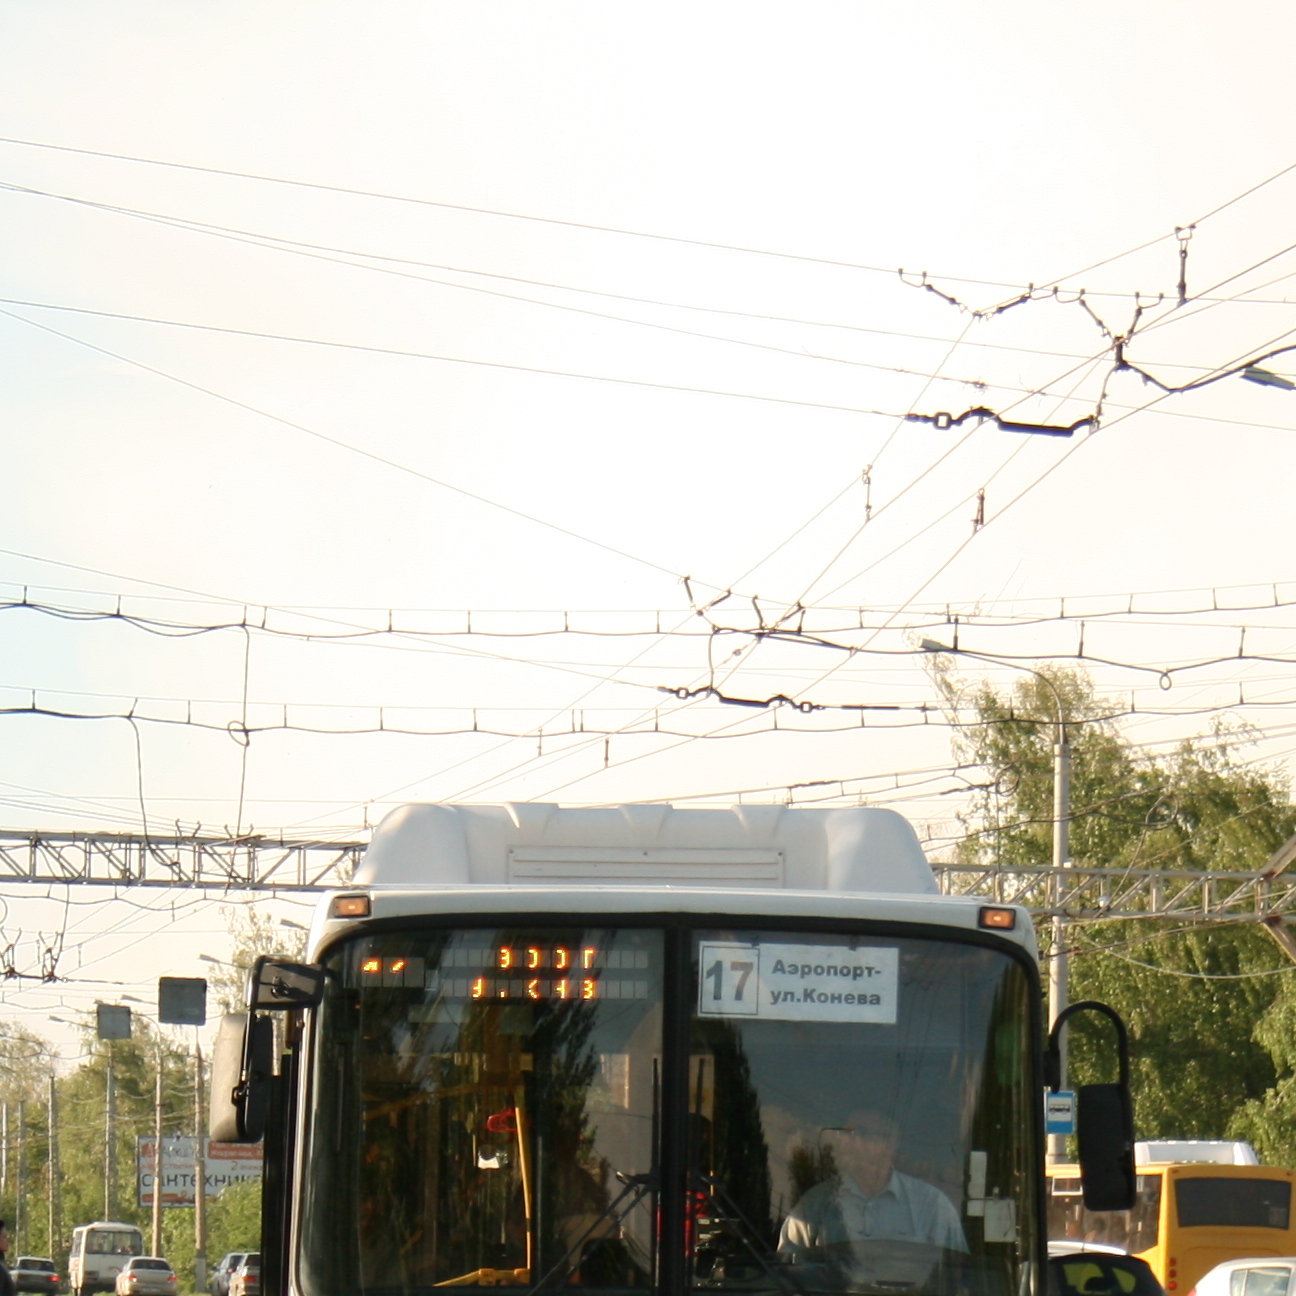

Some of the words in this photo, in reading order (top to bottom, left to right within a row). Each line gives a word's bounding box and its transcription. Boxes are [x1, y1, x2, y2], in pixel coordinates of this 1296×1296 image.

[771, 959, 882, 980] Аэропорт-
[706, 960, 754, 1001] 17
[770, 988, 882, 1006] ул.Конева
